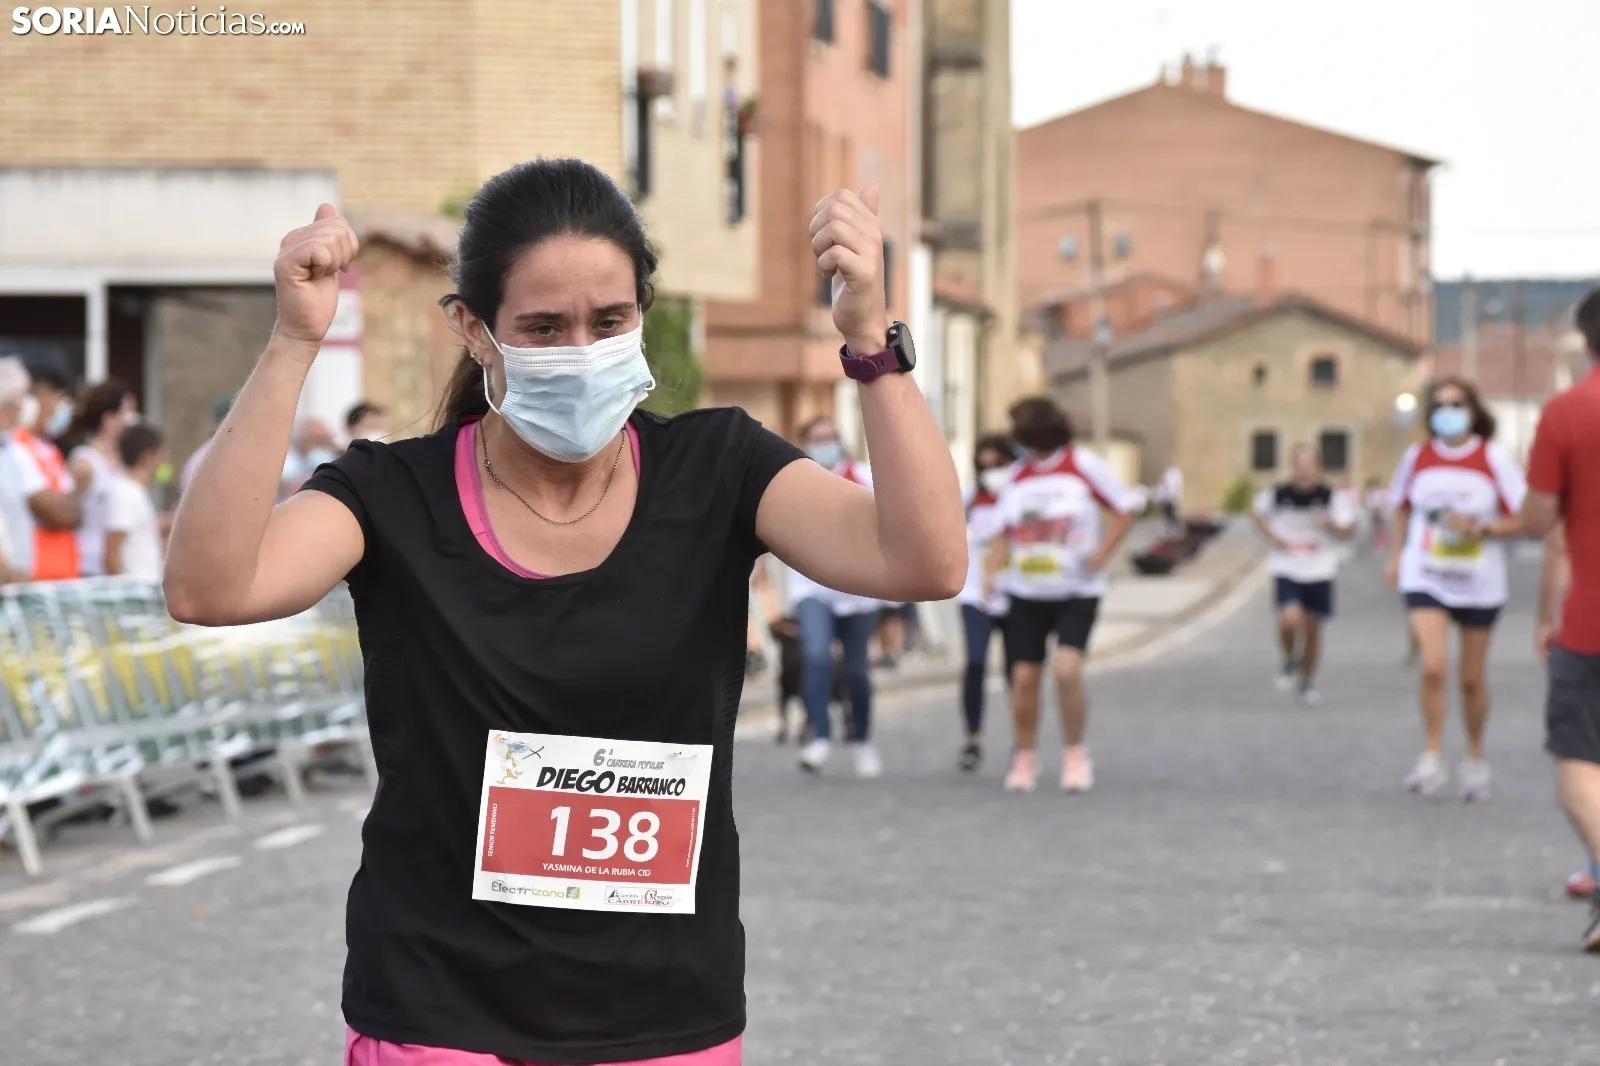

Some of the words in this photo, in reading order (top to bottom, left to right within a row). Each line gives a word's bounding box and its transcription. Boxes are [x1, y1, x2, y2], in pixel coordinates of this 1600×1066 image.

[607, 759, 636, 768] CARRERA
[637, 760, 665, 770] POPULAR
[536, 766, 616, 793] DIEGO
[616, 775, 686, 796] BARRANCO
[490, 803, 498, 835] FEMENINO
[487, 835, 495, 857] SENIOR
[551, 806, 660, 862] 138
[543, 862, 583, 873] YASMINA
[585, 866, 597, 874] DE
[598, 867, 610, 875] LA
[611, 868, 636, 877] RUBIA
[637, 869, 651, 877] CID
